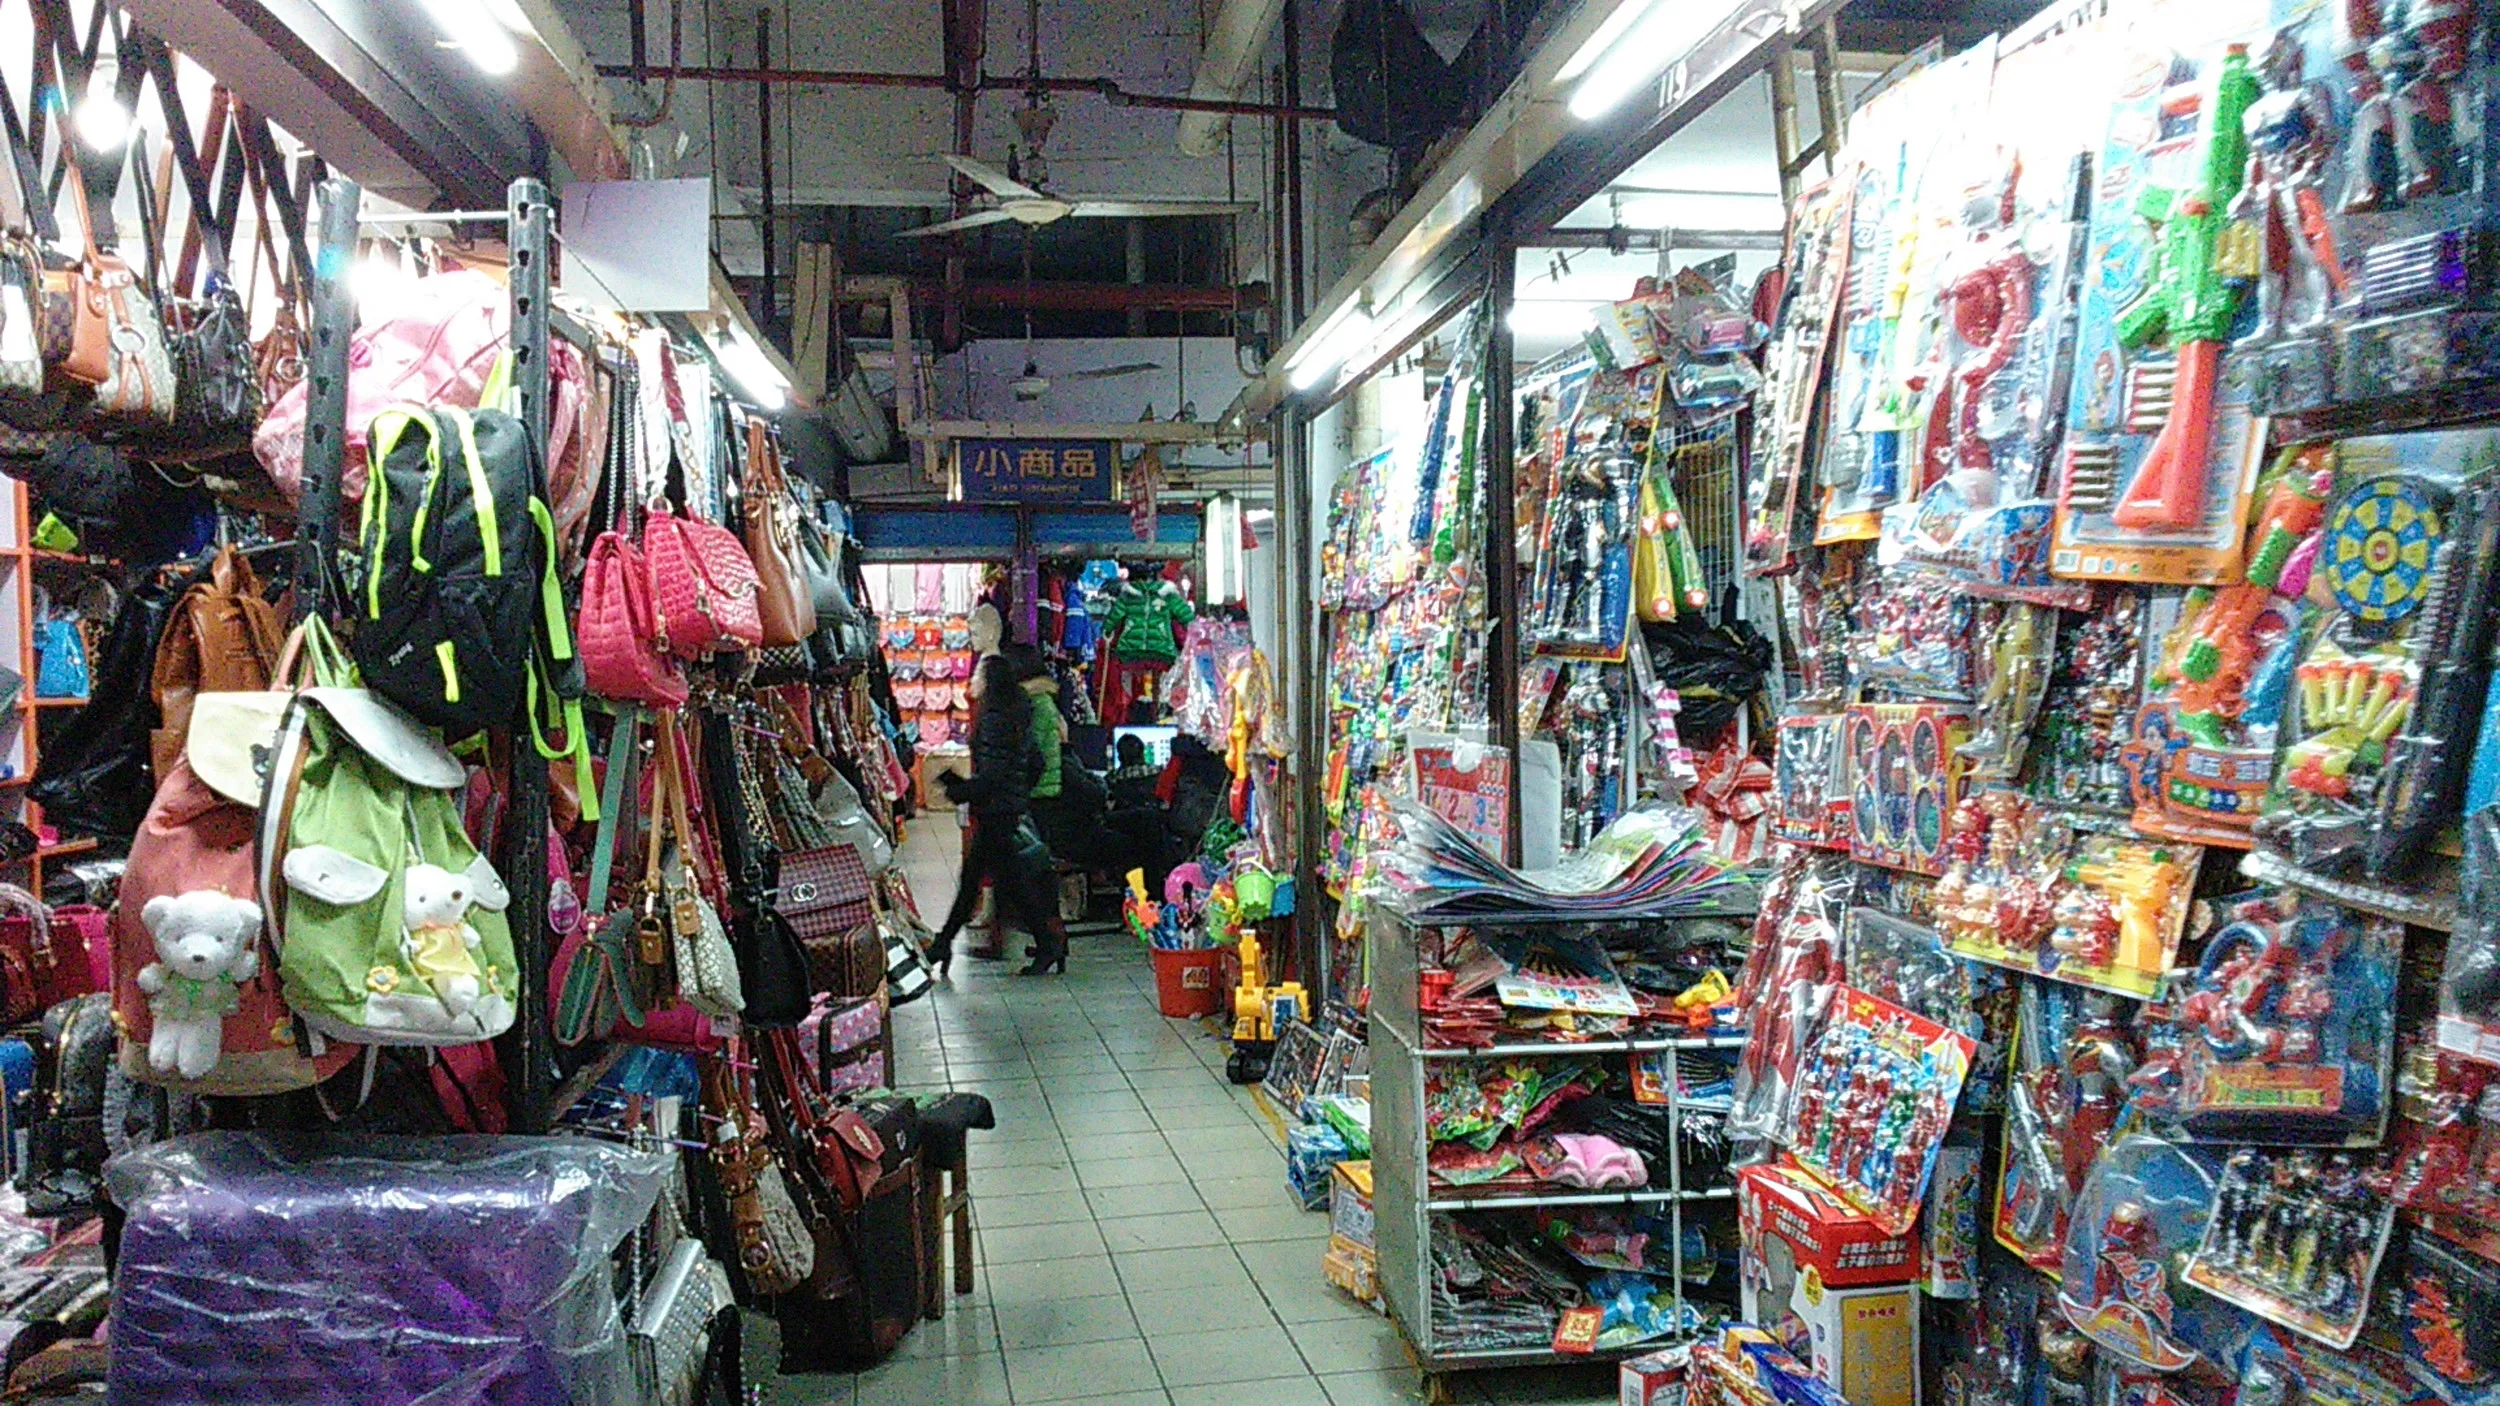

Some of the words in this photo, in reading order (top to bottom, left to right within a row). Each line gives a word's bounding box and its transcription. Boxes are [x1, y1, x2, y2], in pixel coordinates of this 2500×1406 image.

[974, 447, 1097, 478] 小商品
[1448, 793, 1460, 821] 2
[1474, 796, 1487, 827] 3
